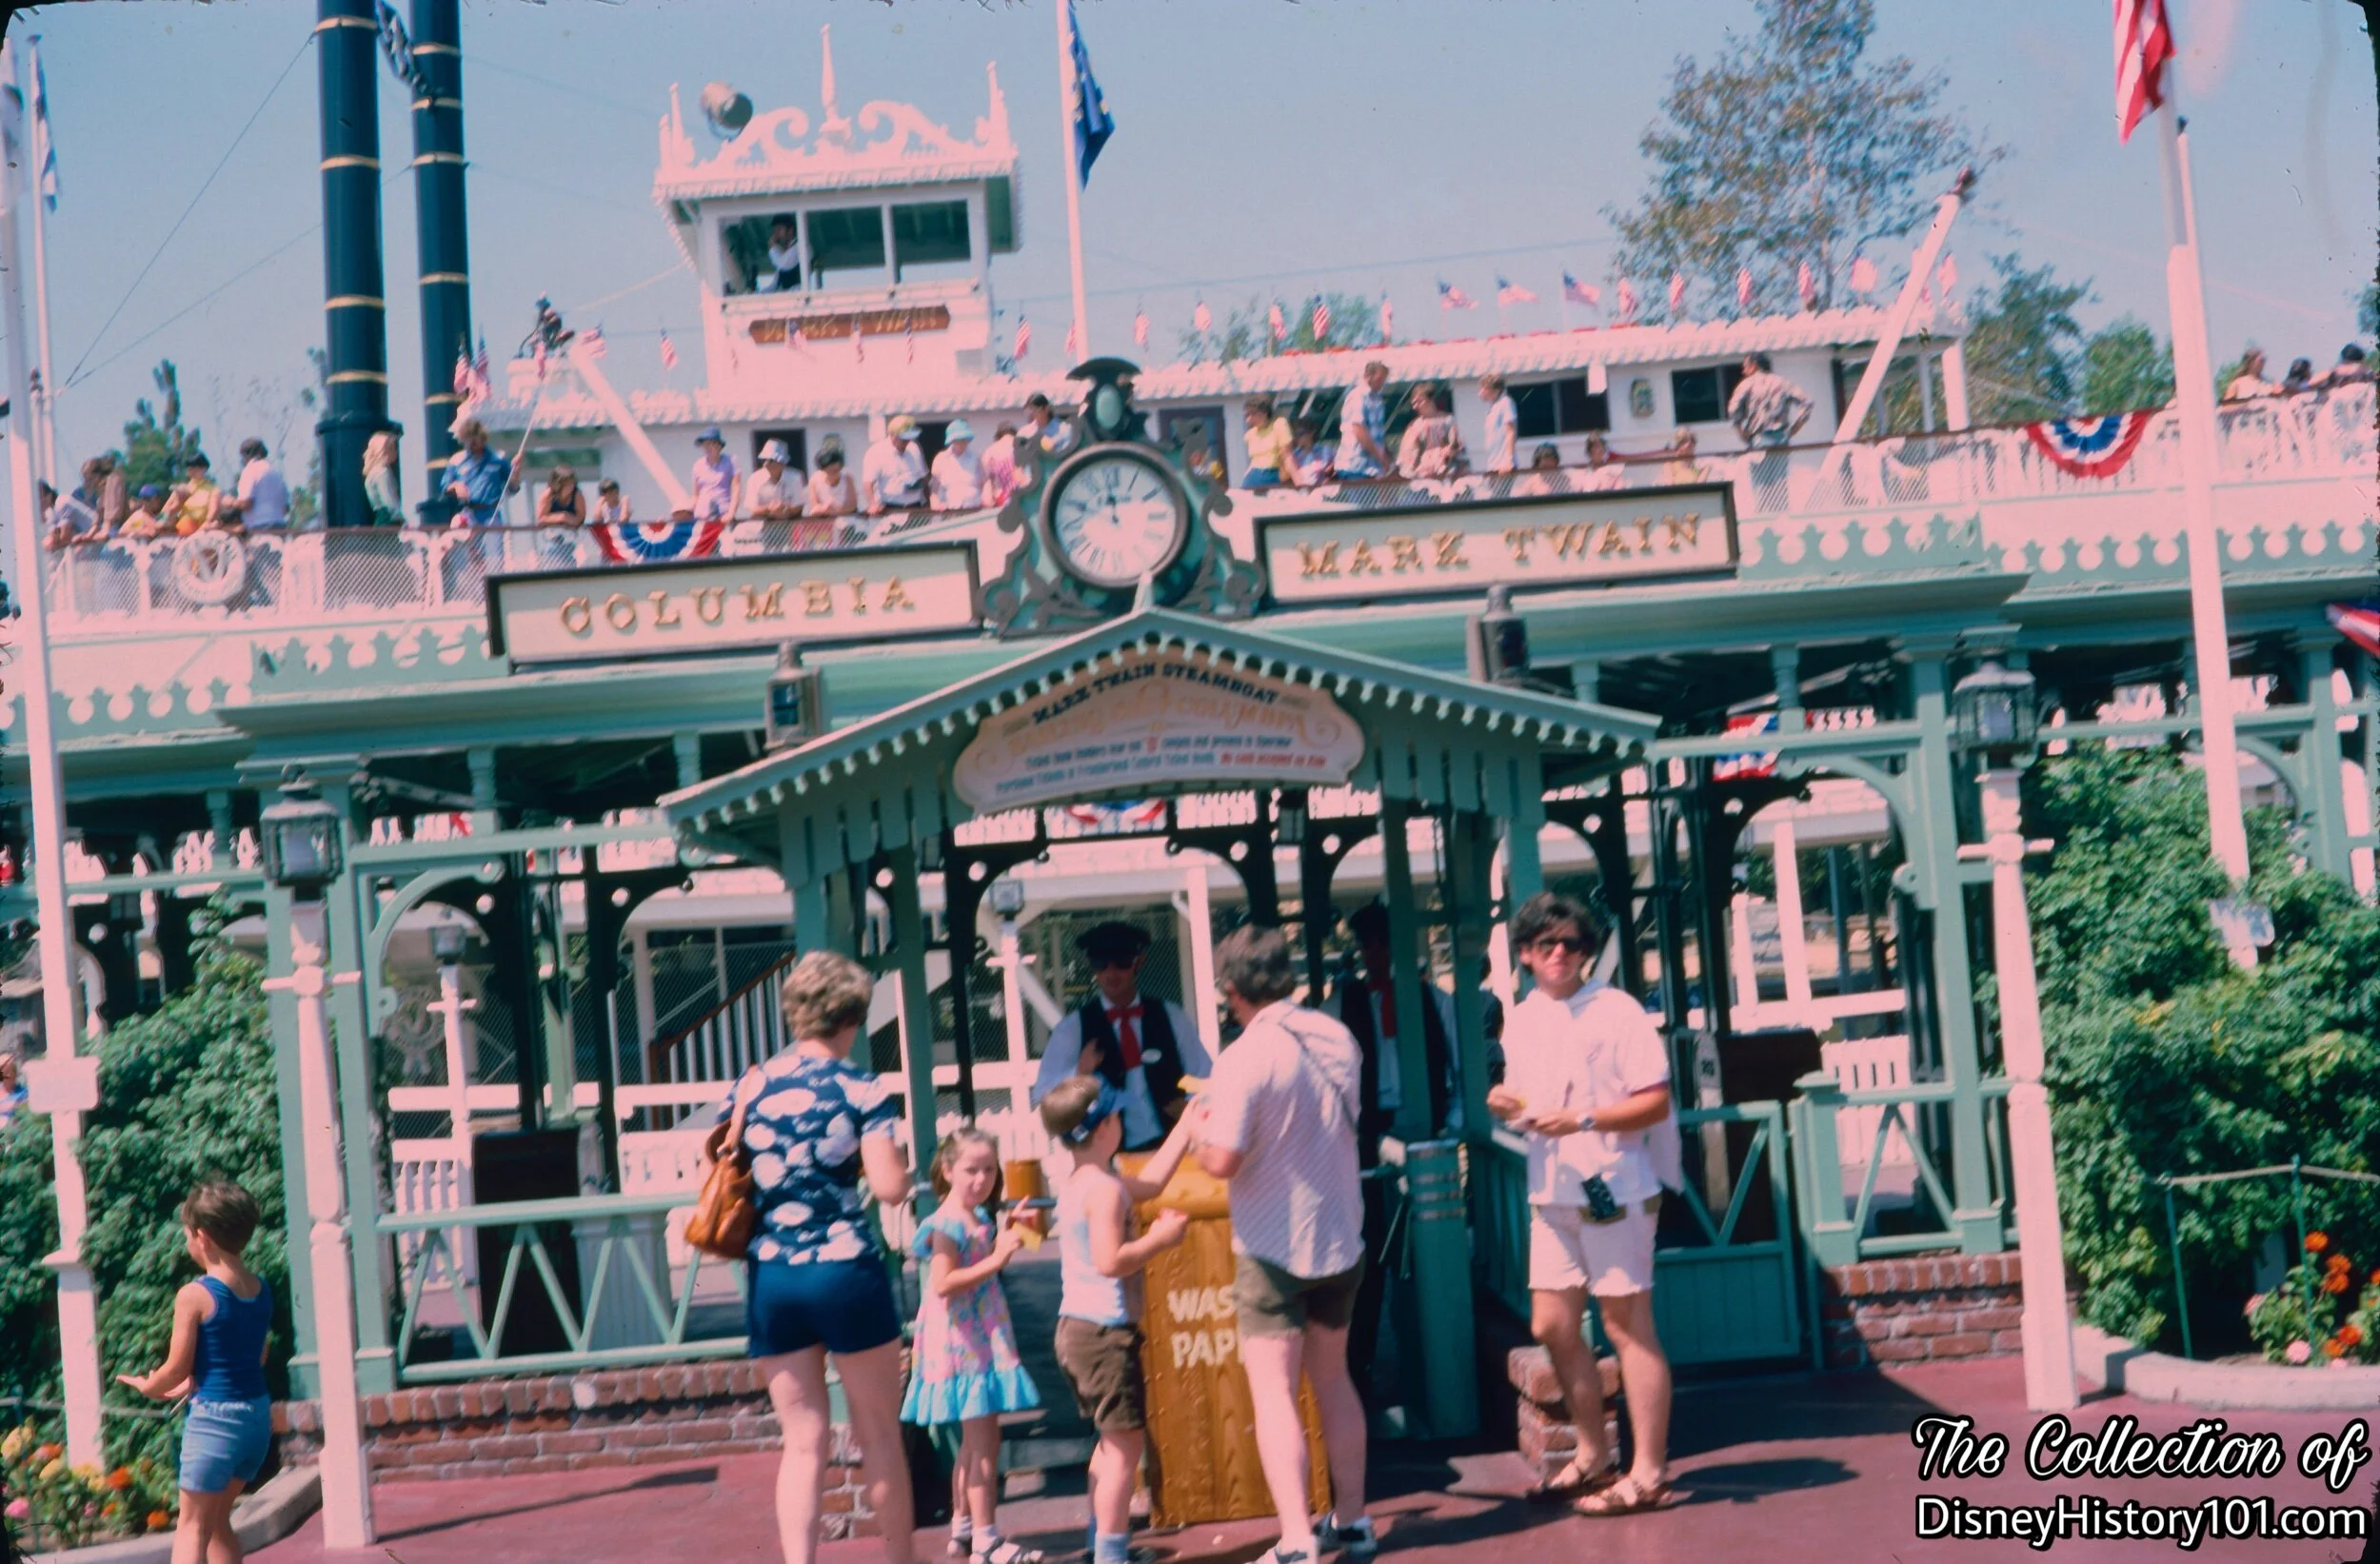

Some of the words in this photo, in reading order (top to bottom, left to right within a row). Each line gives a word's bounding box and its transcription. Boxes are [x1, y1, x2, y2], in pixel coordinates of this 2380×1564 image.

[1294, 529, 1470, 577] MARK
[1501, 511, 1701, 563] TWAIN
[559, 575, 915, 634] COLUMBIA
[1032, 685, 1092, 725] MARK
[1092, 662, 1157, 693] TWAIN
[1161, 661, 1279, 704] STEAMBOAT
[1167, 1285, 1238, 1322] WAS
[1171, 1327, 1245, 1369] PAP
